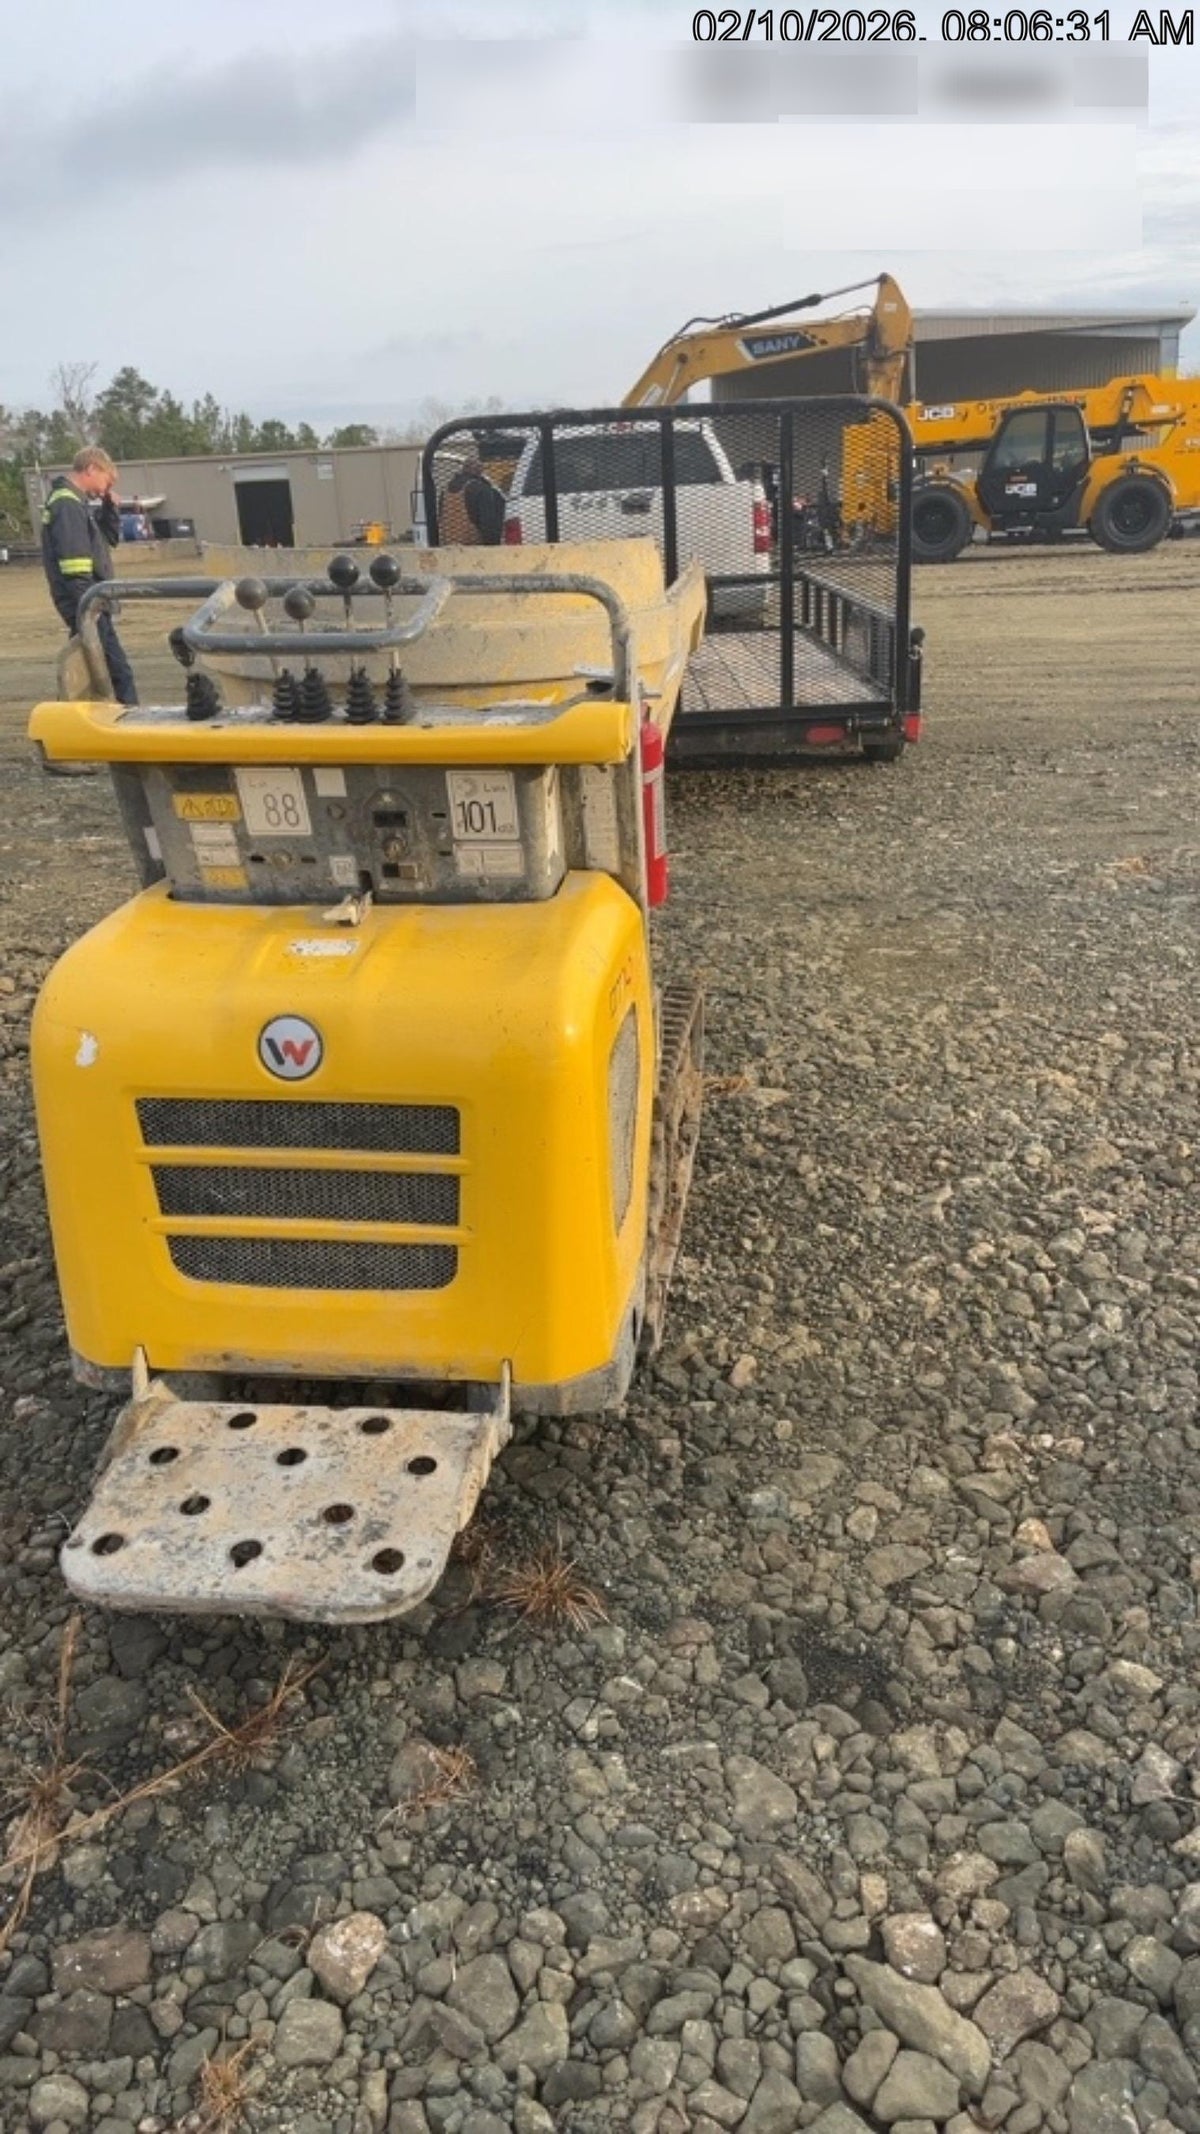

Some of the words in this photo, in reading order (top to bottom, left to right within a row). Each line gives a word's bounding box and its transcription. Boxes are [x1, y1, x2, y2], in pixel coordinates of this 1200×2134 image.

[752, 335, 800, 356] SANY
[917, 407, 954, 420] JCB
[263, 793, 300, 827] 88
[456, 801, 497, 833] 101
